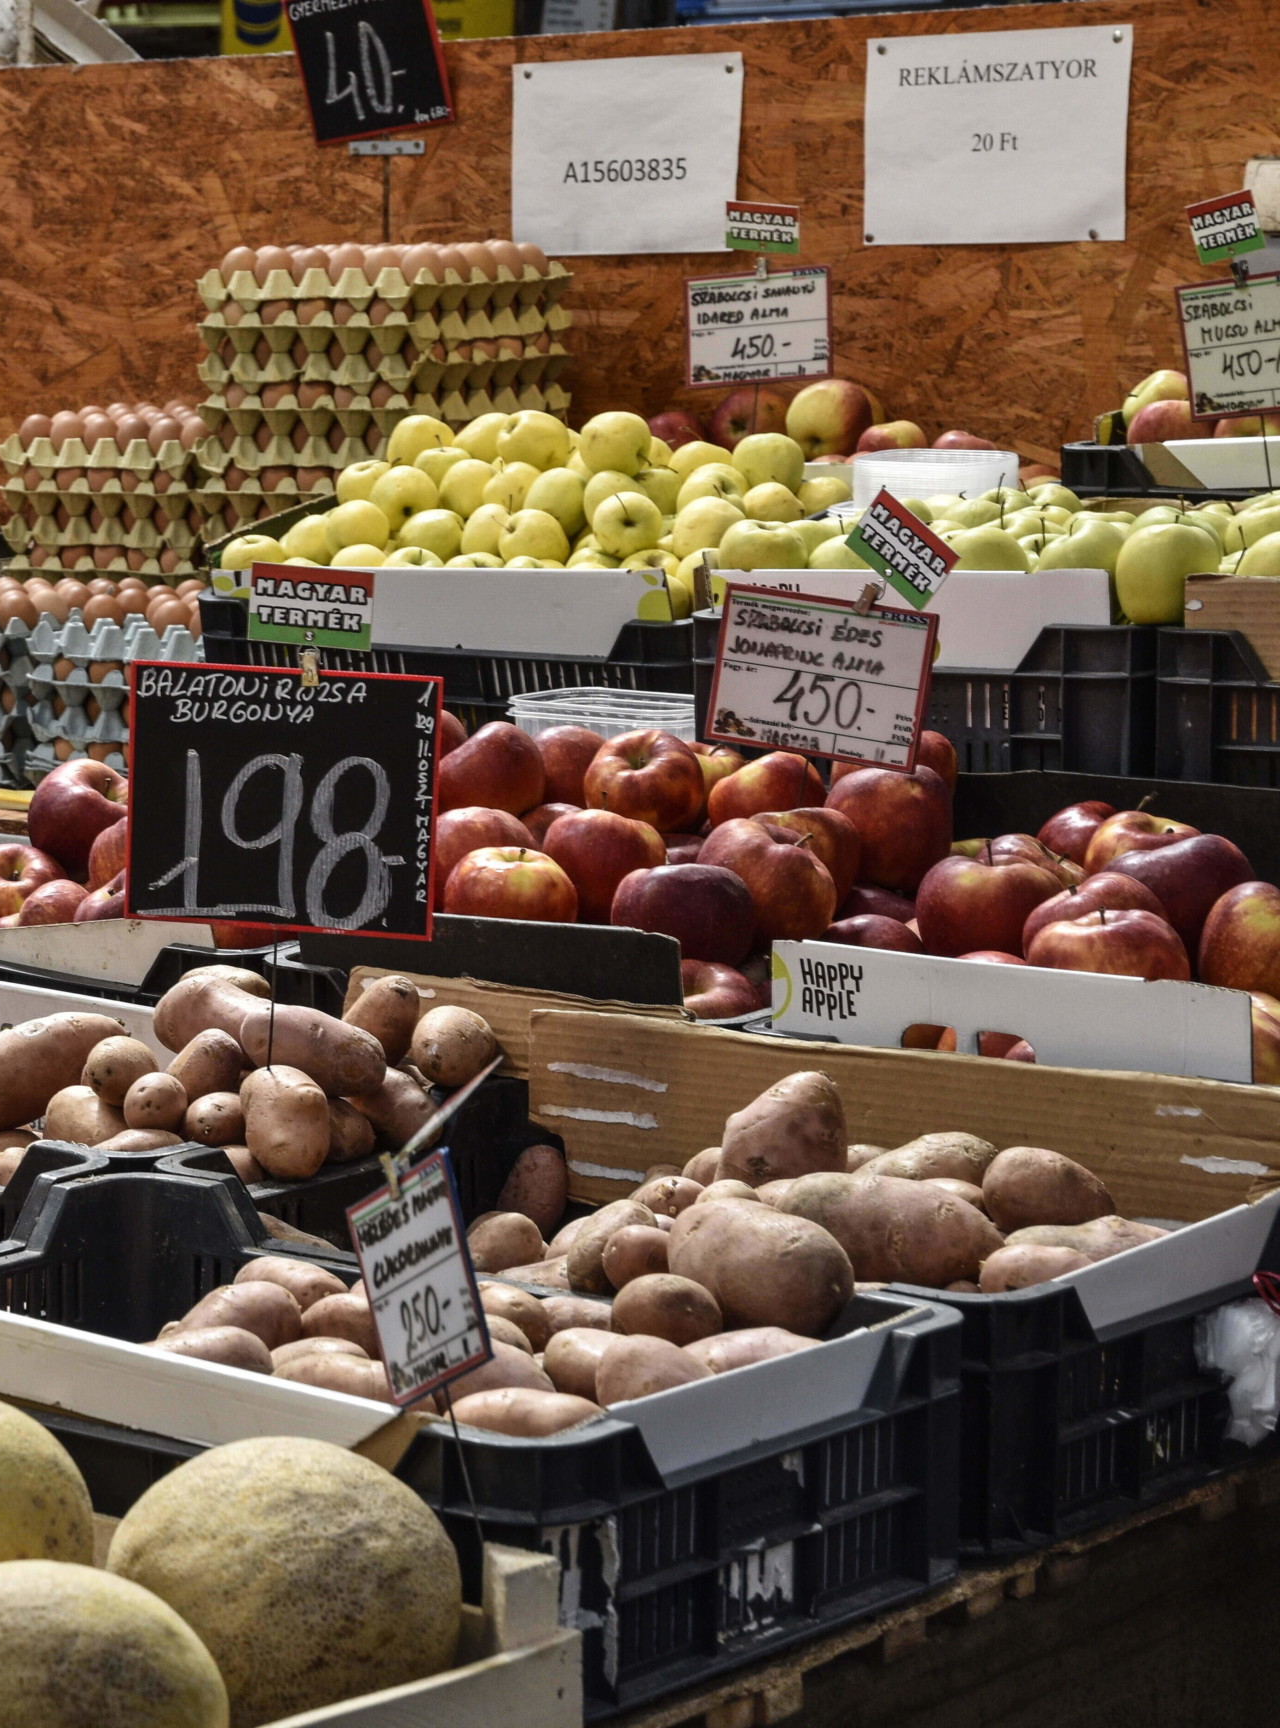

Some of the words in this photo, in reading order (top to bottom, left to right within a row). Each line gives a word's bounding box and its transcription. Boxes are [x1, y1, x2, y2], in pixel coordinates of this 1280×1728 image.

[898, 58, 1098, 87] REKLÁMSZATYOR
[971, 133, 994, 152] 20
[999, 132, 1018, 151] Ft
[563, 157, 687, 184] A15603835
[729, 210, 796, 227] MAGYAR
[1192, 202, 1254, 231] MAGYAR
[731, 227, 794, 243] TERMÉK
[1199, 223, 1257, 251] TERMÉK
[697, 310, 744, 326] IDARED
[750, 306, 789, 321] ALMA
[870, 503, 948, 578] MAGYAR
[860, 524, 932, 594] TERMÉK
[255, 576, 368, 605] MAGYAR
[258, 604, 363, 632] TERMÉK
[881, 610, 929, 624] FRISS
[830, 617, 884, 648] ÉDES
[831, 651, 885, 676] ALMA
[170, 698, 316, 724] BURGONYA
[799, 957, 864, 993] HAPPY
[801, 986, 858, 1022] APPLE
